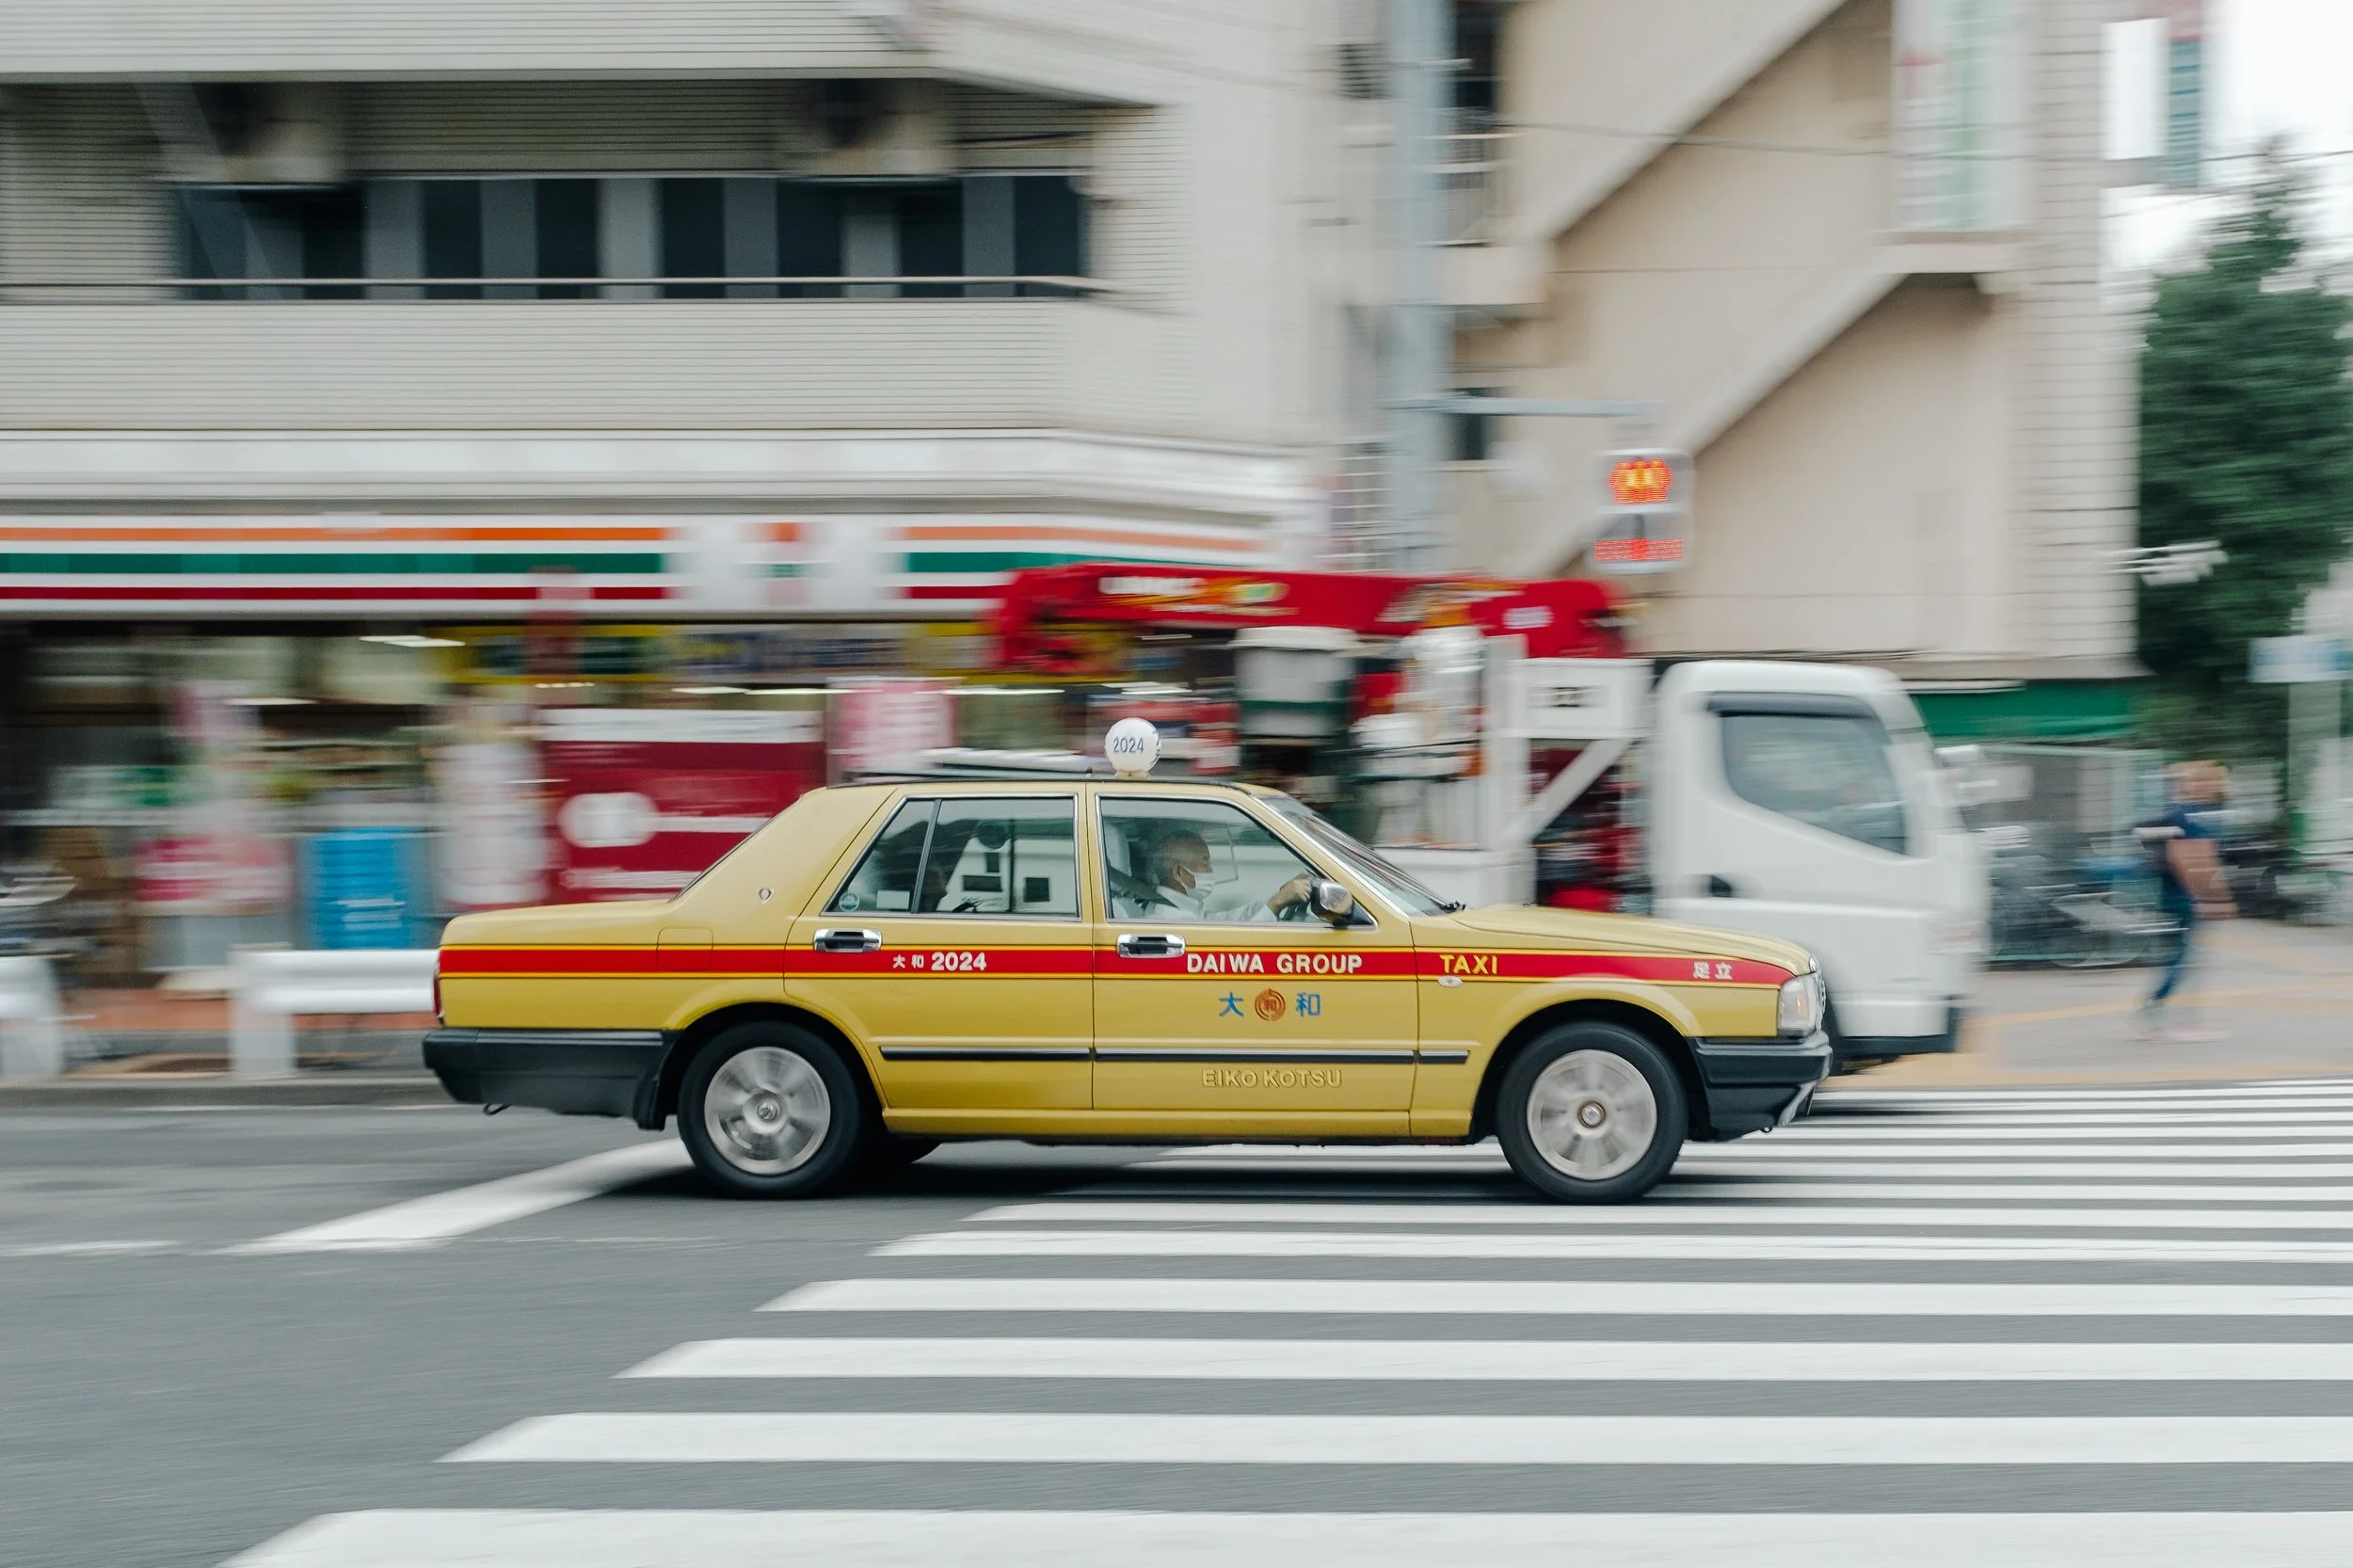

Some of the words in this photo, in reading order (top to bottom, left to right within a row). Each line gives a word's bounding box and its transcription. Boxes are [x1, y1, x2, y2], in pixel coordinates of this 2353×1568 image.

[1113, 737, 1144, 754] 2024
[892, 953, 925, 969] 大和
[931, 952, 987, 971] 2024
[1187, 953, 1264, 973] DAIWA
[1276, 953, 1363, 974] GROUP
[1439, 953, 1498, 975] TAXI
[1202, 1069, 1258, 1088] EIKO
[1263, 1069, 1342, 1088] KOTSU
